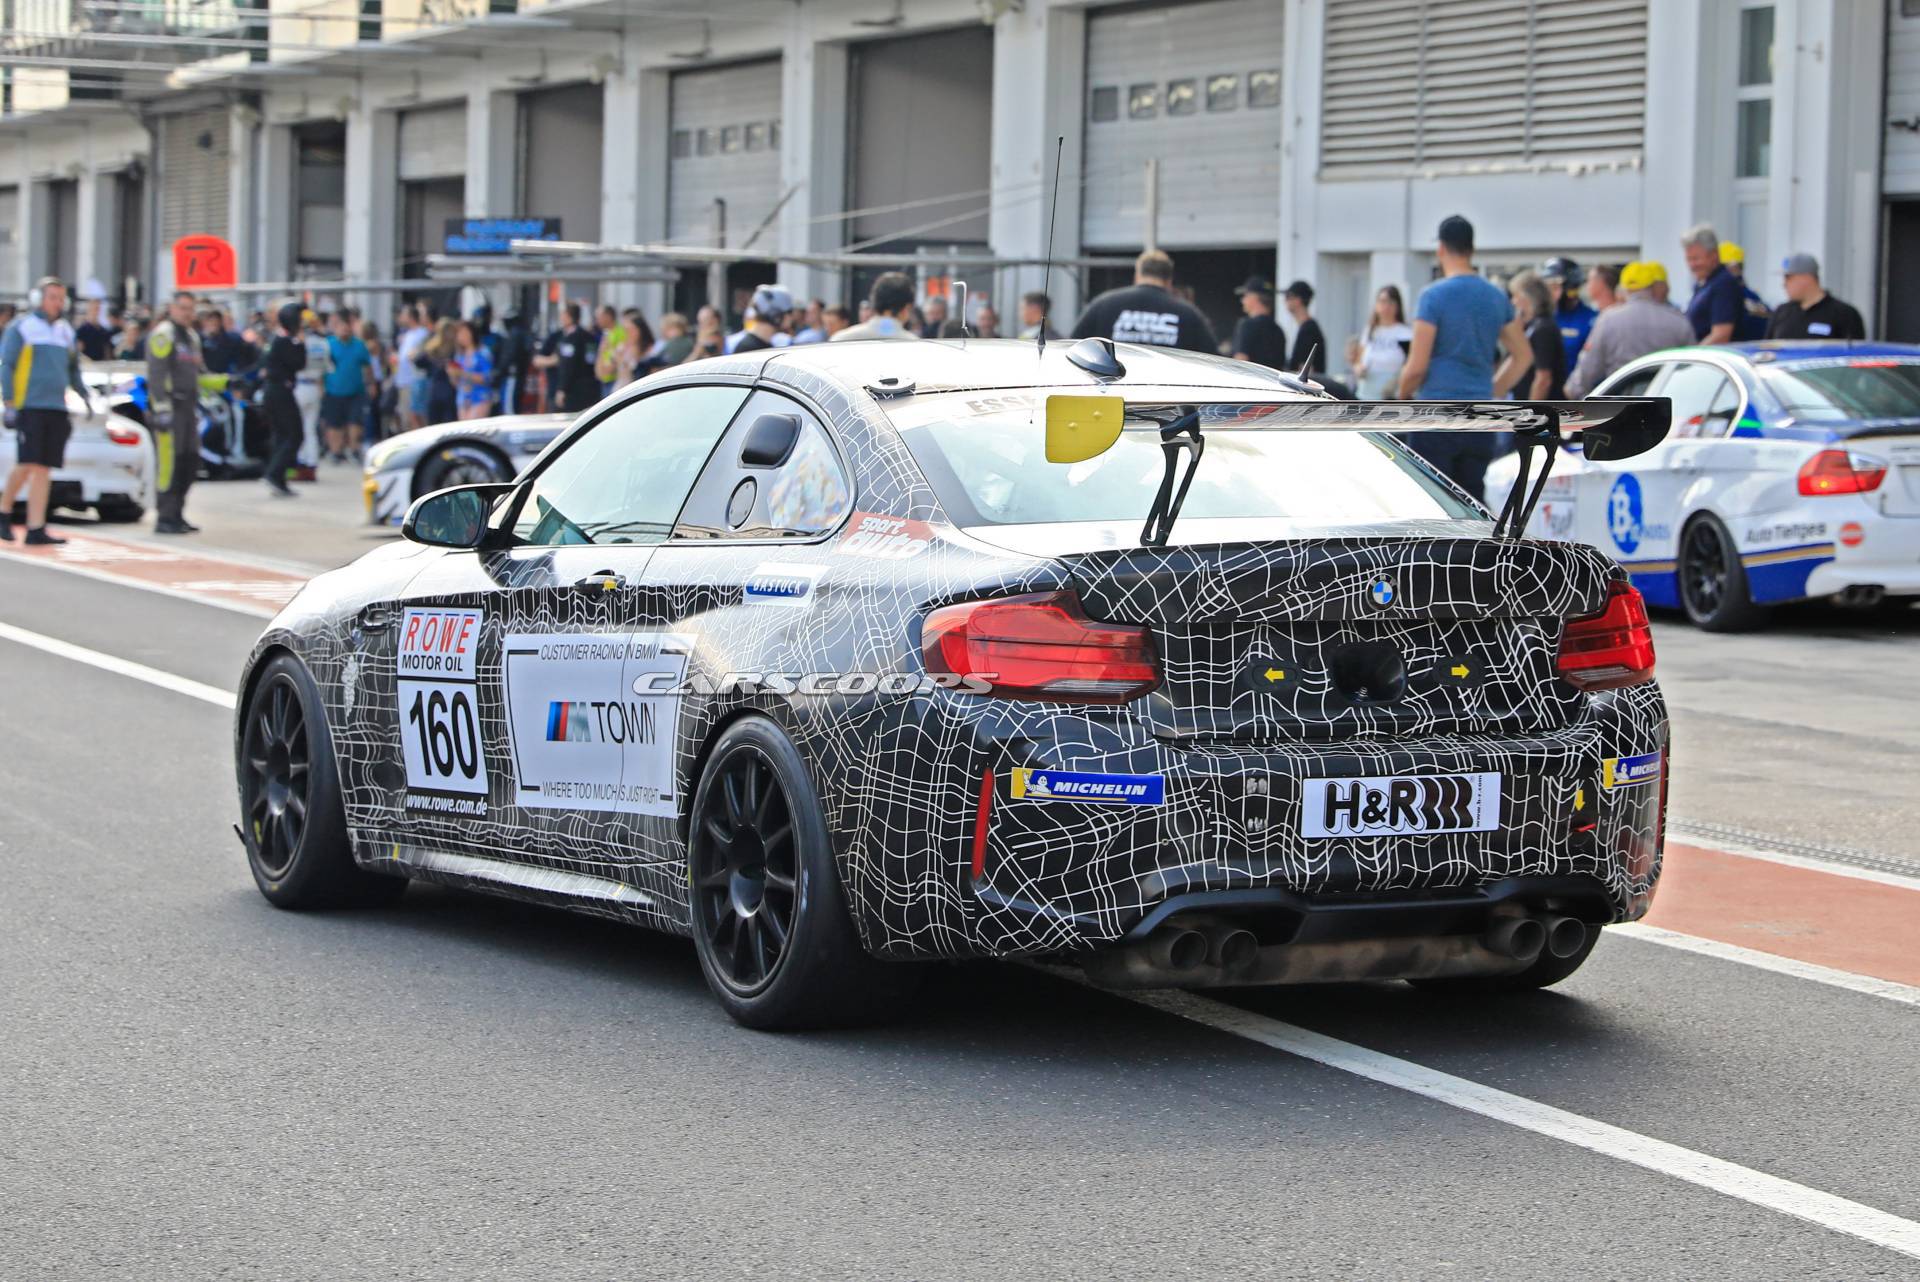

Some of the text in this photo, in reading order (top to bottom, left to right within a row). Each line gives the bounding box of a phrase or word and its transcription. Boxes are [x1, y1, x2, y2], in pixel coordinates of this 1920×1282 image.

[858, 516, 906, 535] sport
[840, 531, 929, 558] auto
[752, 578, 803, 595] BASTUCK
[403, 616, 475, 654] ROWE
[402, 654, 464, 673] MOTOR OIL
[540, 643, 590, 661] CUSTOMER
[591, 643, 623, 660] RACING
[635, 643, 660, 660] BMW
[409, 689, 478, 780] 160
[591, 701, 656, 745] TOWN
[542, 781, 573, 800] WHERE
[574, 782, 593, 800] TOO
[593, 783, 617, 801] MUCH
[626, 785, 643, 804] JUST
[643, 786, 660, 806] RIGHT
[1053, 781, 1148, 797] MICHELIN
[406, 793, 488, 816] www.rowe.com.de
